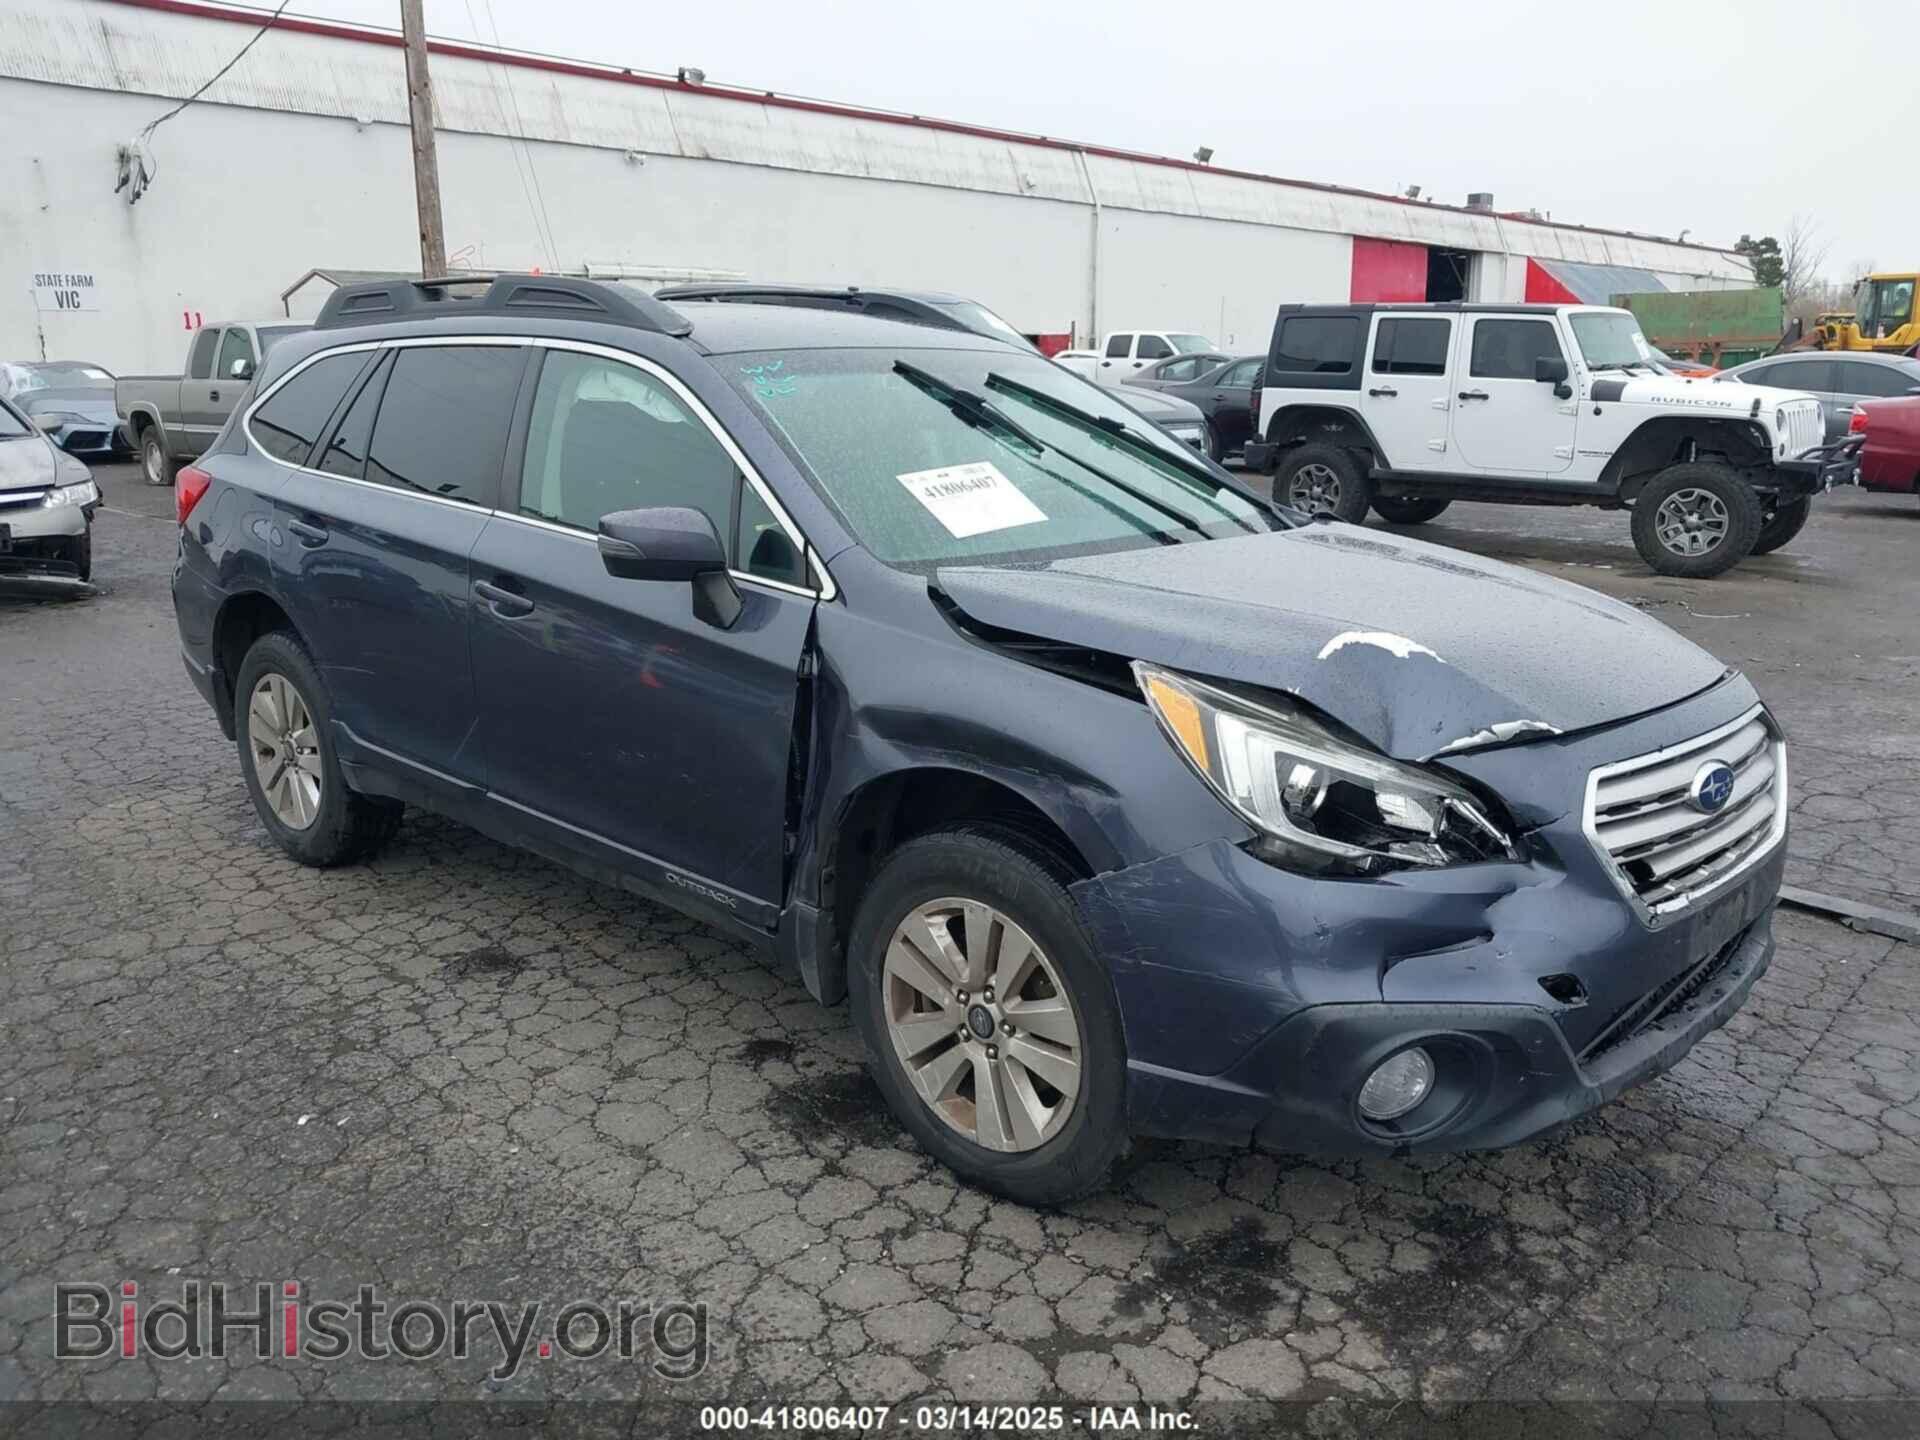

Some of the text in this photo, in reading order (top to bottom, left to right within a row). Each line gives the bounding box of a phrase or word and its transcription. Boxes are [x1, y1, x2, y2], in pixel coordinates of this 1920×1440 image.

[35, 274, 94, 288] STATE FARM
[55, 290, 81, 309] VIC
[1650, 396, 1732, 408] RUBICON
[924, 475, 998, 499] 41806407
